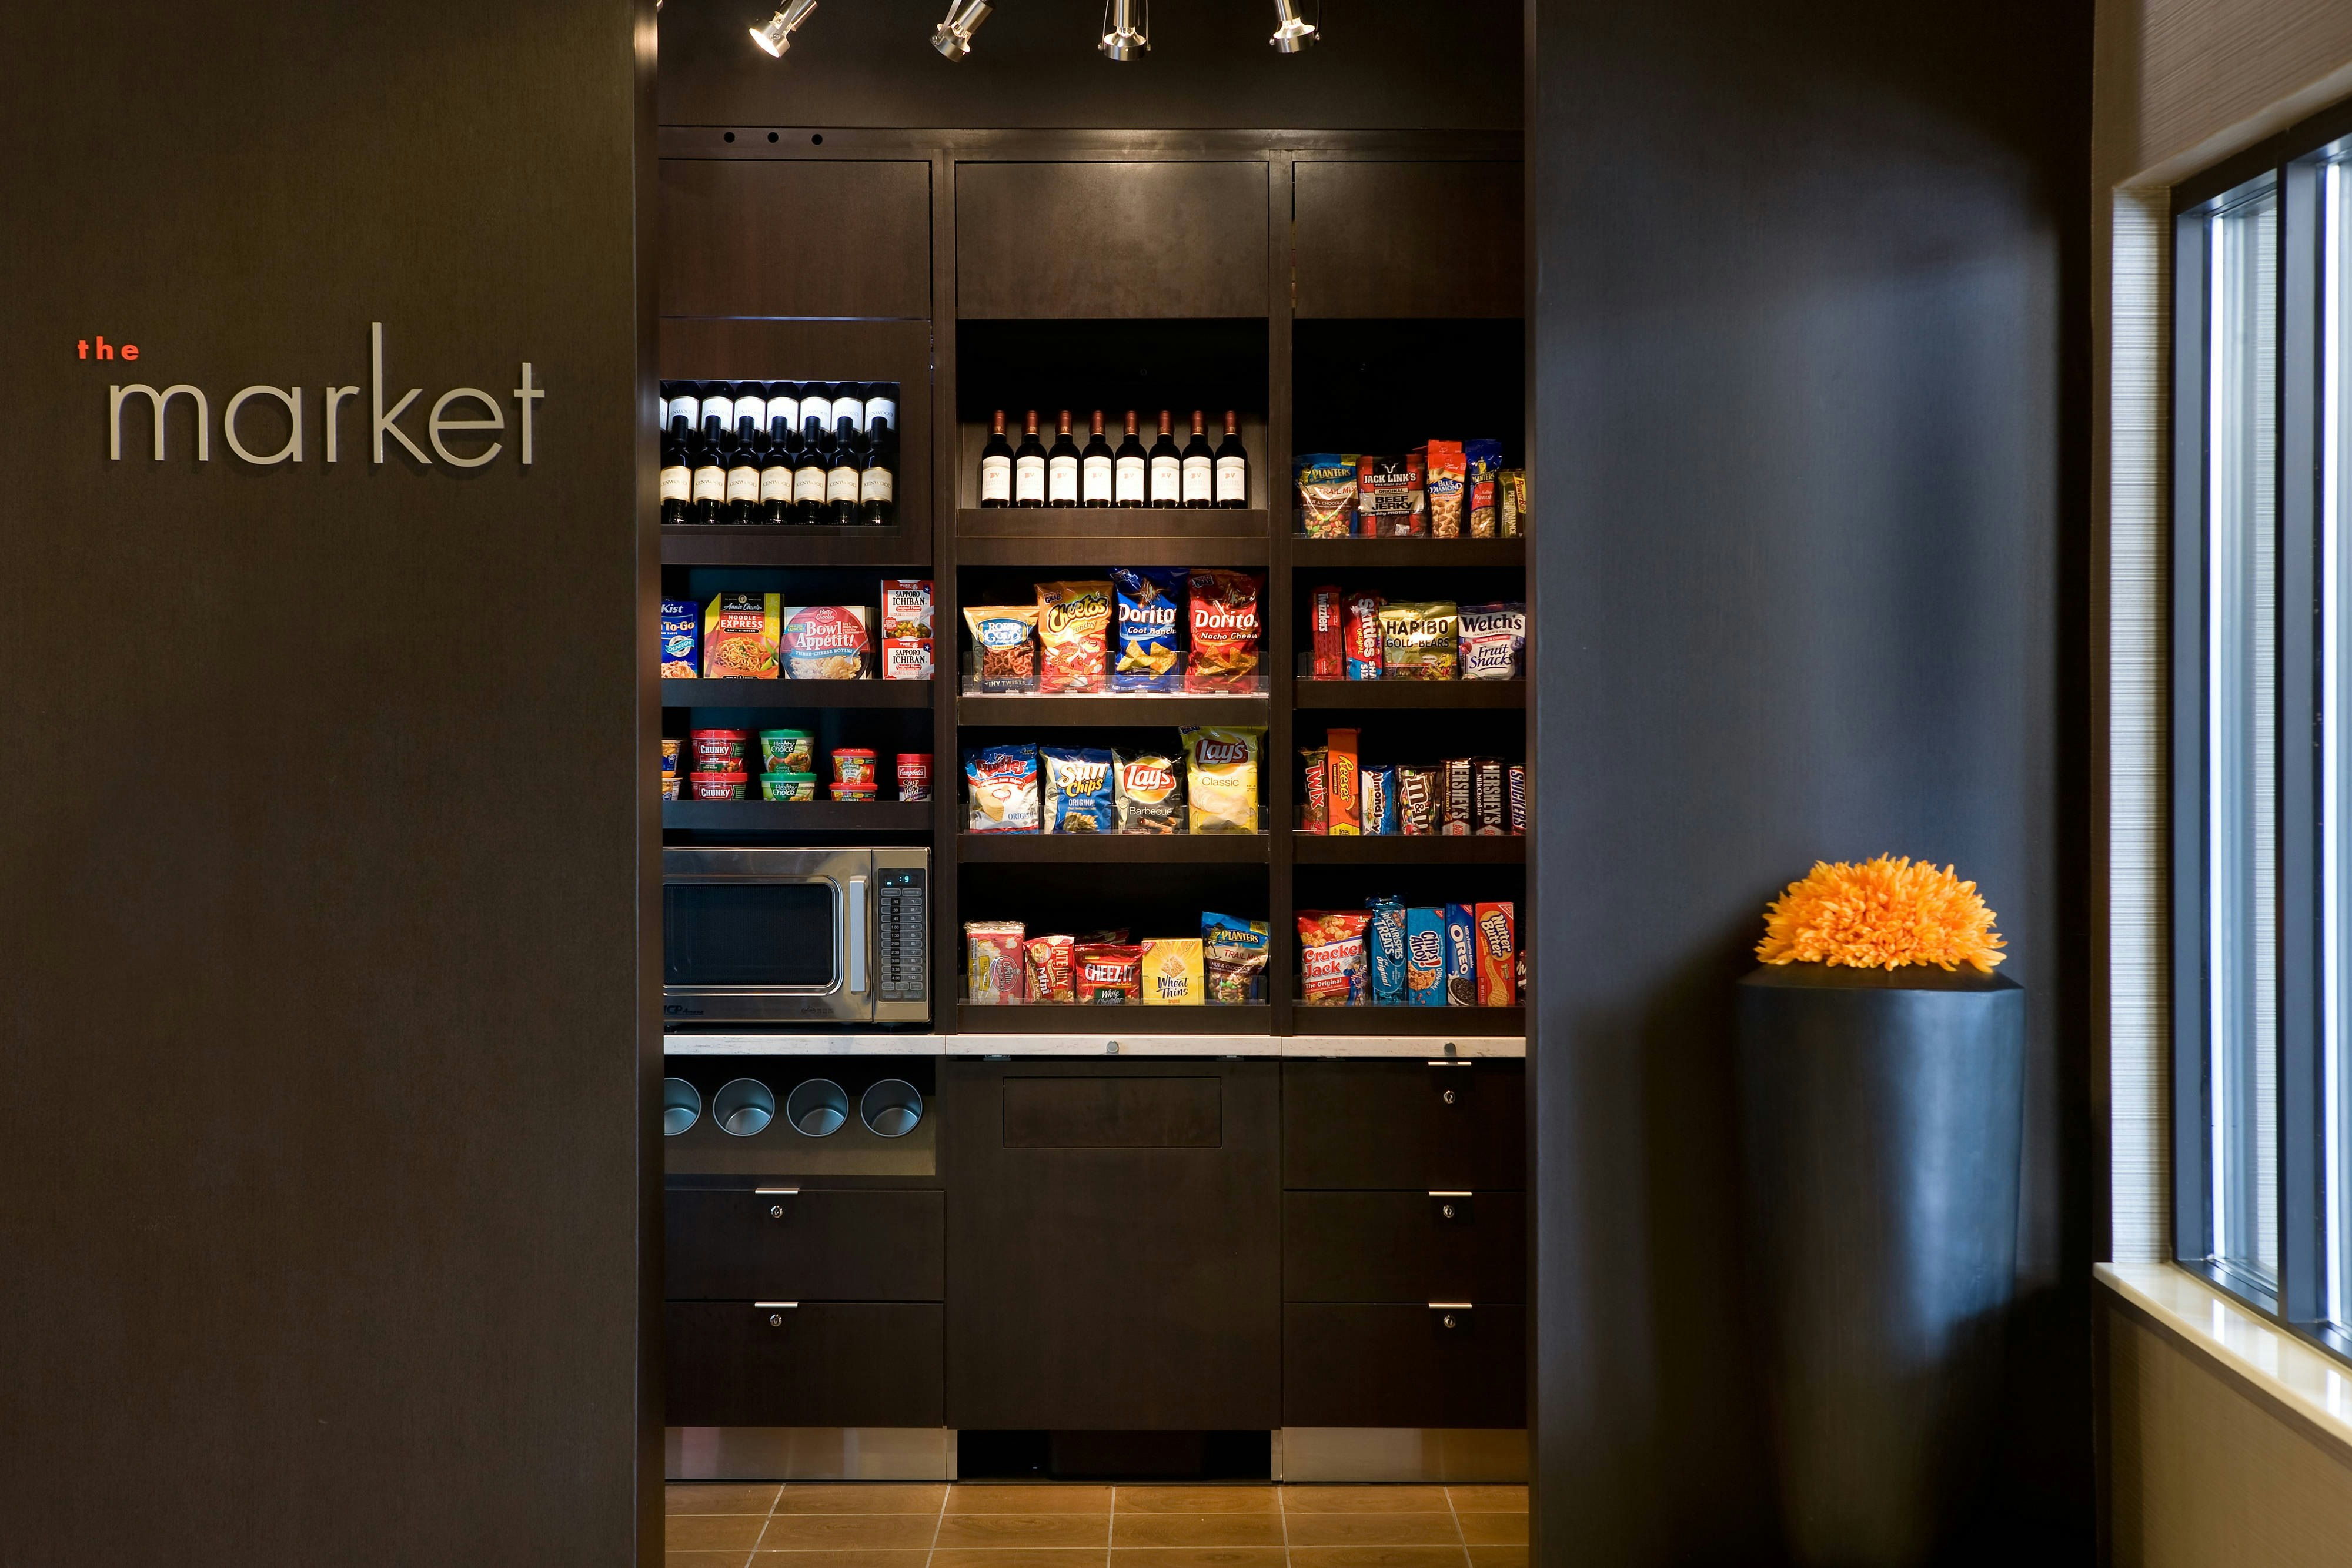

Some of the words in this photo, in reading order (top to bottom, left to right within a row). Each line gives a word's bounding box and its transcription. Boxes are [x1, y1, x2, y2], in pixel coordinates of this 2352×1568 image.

[78, 336, 139, 360] the
[110, 322, 544, 467] market
[867, 409, 893, 418] KENWOOD
[1312, 469, 1351, 480] PLANTERS
[1364, 474, 1386, 483] JACK
[1388, 472, 1416, 483] LINK'S
[696, 479, 723, 487] KENWOOD
[729, 479, 757, 488] KENWOOD
[763, 480, 790, 488] KENWOOD
[796, 480, 824, 488] KENWOOD
[829, 480, 857, 488] KENWOOD
[864, 480, 891, 489] KENWOOD
[1342, 485, 1357, 494] MIX
[1430, 483, 1462, 493] DIAMOND
[1372, 502, 1413, 510] JERKY
[1508, 490, 1516, 536] PERFORMANCE
[723, 602, 742, 610] Annie
[893, 597, 925, 606] ICHIBAN
[1050, 594, 1108, 632] Cheetos
[1318, 592, 1330, 632] Twizzlers
[663, 621, 695, 631] To-Go
[721, 620, 763, 628] EXPRESS
[805, 621, 842, 636] Bowl
[1073, 620, 1096, 634] runchy
[1358, 599, 1377, 657] Skittles
[1387, 620, 1448, 636] HARIBO
[1461, 614, 1522, 633] Welch's
[795, 633, 854, 651] Appétit!
[1201, 632, 1227, 640] Nacho
[1387, 638, 1449, 648] GOLD-BEARS
[1478, 644, 1509, 657] Fruit
[1469, 654, 1514, 669] Snacks
[701, 745, 729, 755] CHUNKY
[1198, 740, 1245, 764] Lay's
[900, 768, 924, 777] Campbell's
[1057, 763, 1108, 788] Sun
[1127, 765, 1170, 791] Lay's
[1339, 755, 1354, 802] Reese's
[903, 779, 919, 789] Soup
[1066, 778, 1104, 797] Chips
[1202, 777, 1239, 787] Classic
[701, 788, 730, 797] CHUNKY
[1371, 771, 1383, 814] Almond
[1452, 761, 1470, 819] HERSHEY'S
[1482, 765, 1501, 824] HERSHEY'S
[1068, 798, 1096, 807] ORIGINAL
[1511, 770, 1526, 829] SNICKERS
[1130, 806, 1172, 815] Barbecue
[1371, 814, 1383, 834] Joy
[1222, 930, 1258, 943] PLANTERS
[1374, 917, 1394, 955] TREATS
[1381, 912, 1394, 928] RICE
[1390, 927, 1403, 959] KRISPIES
[1481, 920, 1502, 957] Butter
[1491, 914, 1511, 952] Nutter
[1411, 936, 1441, 967] Ahoy!
[1421, 931, 1439, 960] Chips
[1450, 924, 1468, 974] OREO
[1051, 947, 1070, 966] LATE
[1224, 949, 1245, 960] TRAIL
[1304, 944, 1364, 964] Cracker
[1003, 961, 1012, 985] Orville
[1304, 961, 1341, 978] Jack
[1376, 955, 1391, 987] Original
[1037, 967, 1052, 995] Mini
[1157, 977, 1188, 988] Wheat
[1317, 978, 1342, 988] Original
[1431, 968, 1443, 990] ORIGINAL
[1102, 989, 1120, 998] White
[1156, 987, 1188, 998] Thins
